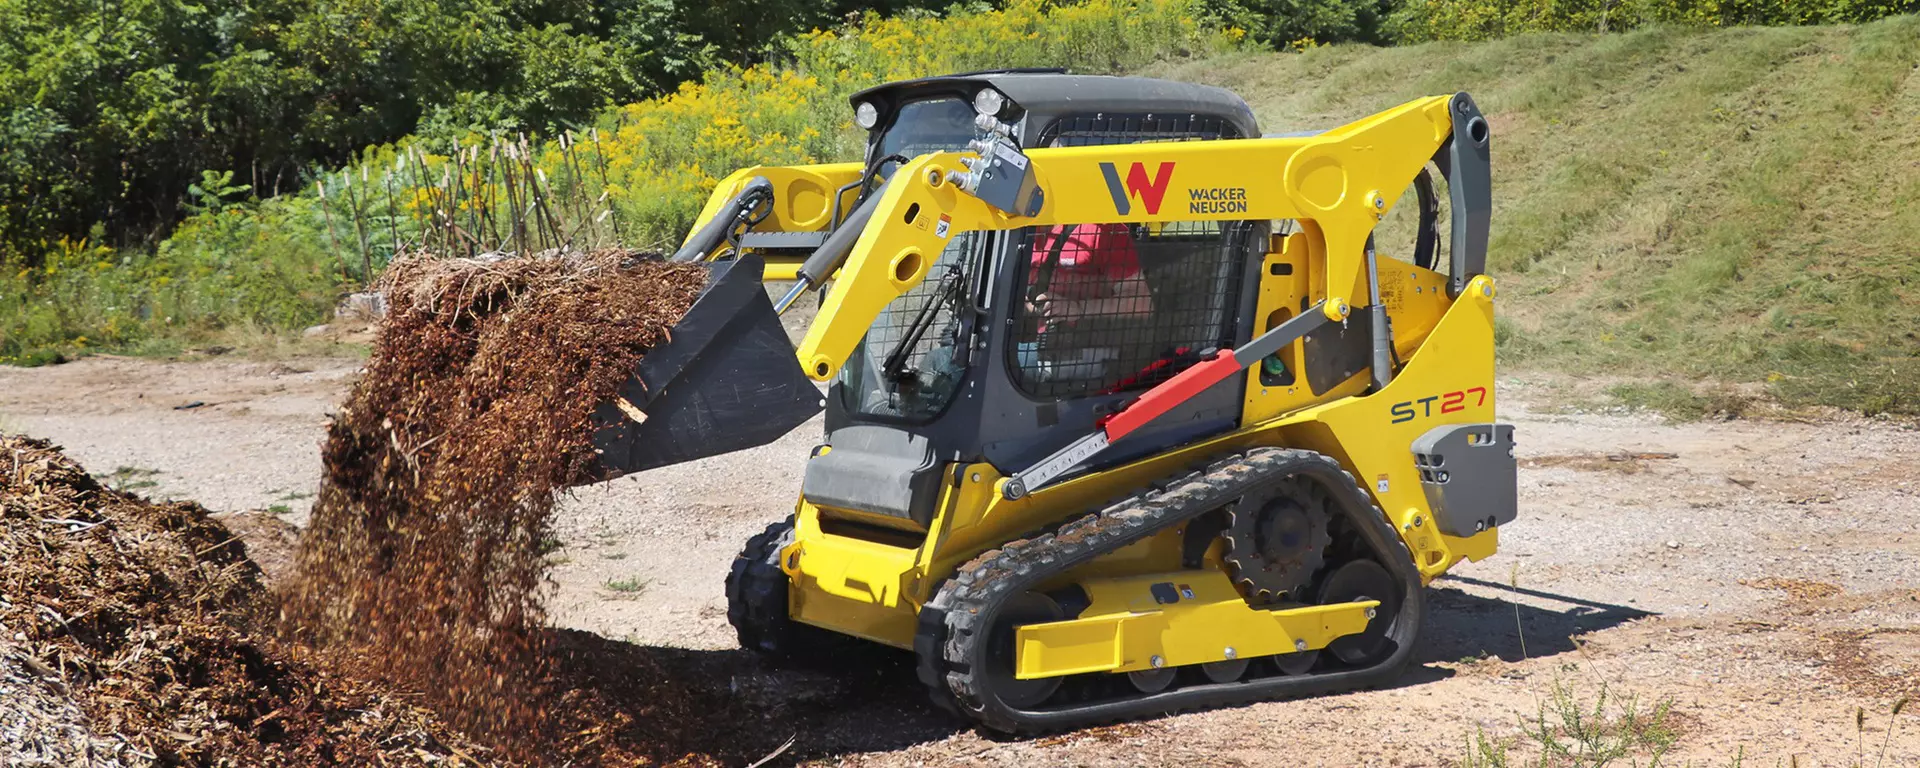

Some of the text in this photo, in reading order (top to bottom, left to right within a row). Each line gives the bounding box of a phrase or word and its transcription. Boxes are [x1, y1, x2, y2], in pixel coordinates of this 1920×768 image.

[1188, 188, 1247, 201] WACKER
[1189, 201, 1247, 214] NEUSON
[1390, 386, 1487, 425] ST27
